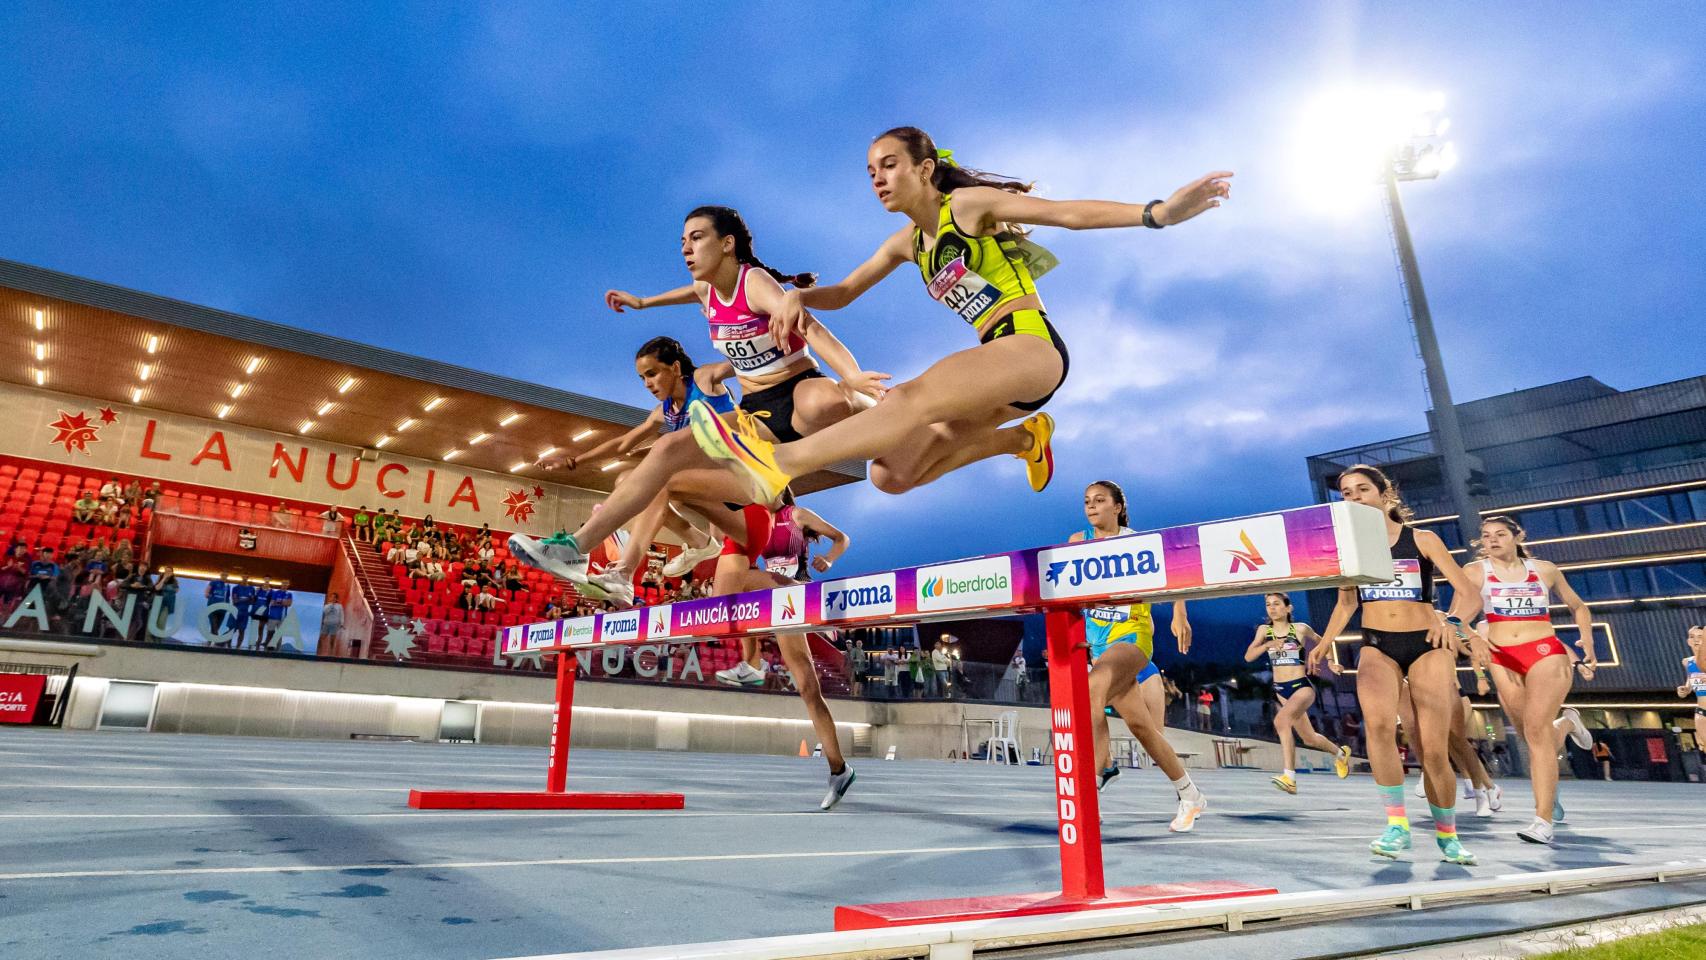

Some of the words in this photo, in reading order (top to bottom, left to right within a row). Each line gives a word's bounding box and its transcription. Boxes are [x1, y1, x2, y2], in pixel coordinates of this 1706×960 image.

[944, 284, 974, 309] 442
[725, 340, 758, 357] 661
[140, 420, 232, 471] LA
[269, 441, 480, 512] NUCIA
[946, 573, 1008, 595] Iberdrola
[680, 610, 693, 627] LA
[695, 602, 729, 625] NUCÍA
[731, 602, 760, 621] 2026
[1506, 597, 1534, 608] 174
[1054, 732, 1077, 845] MONDO
